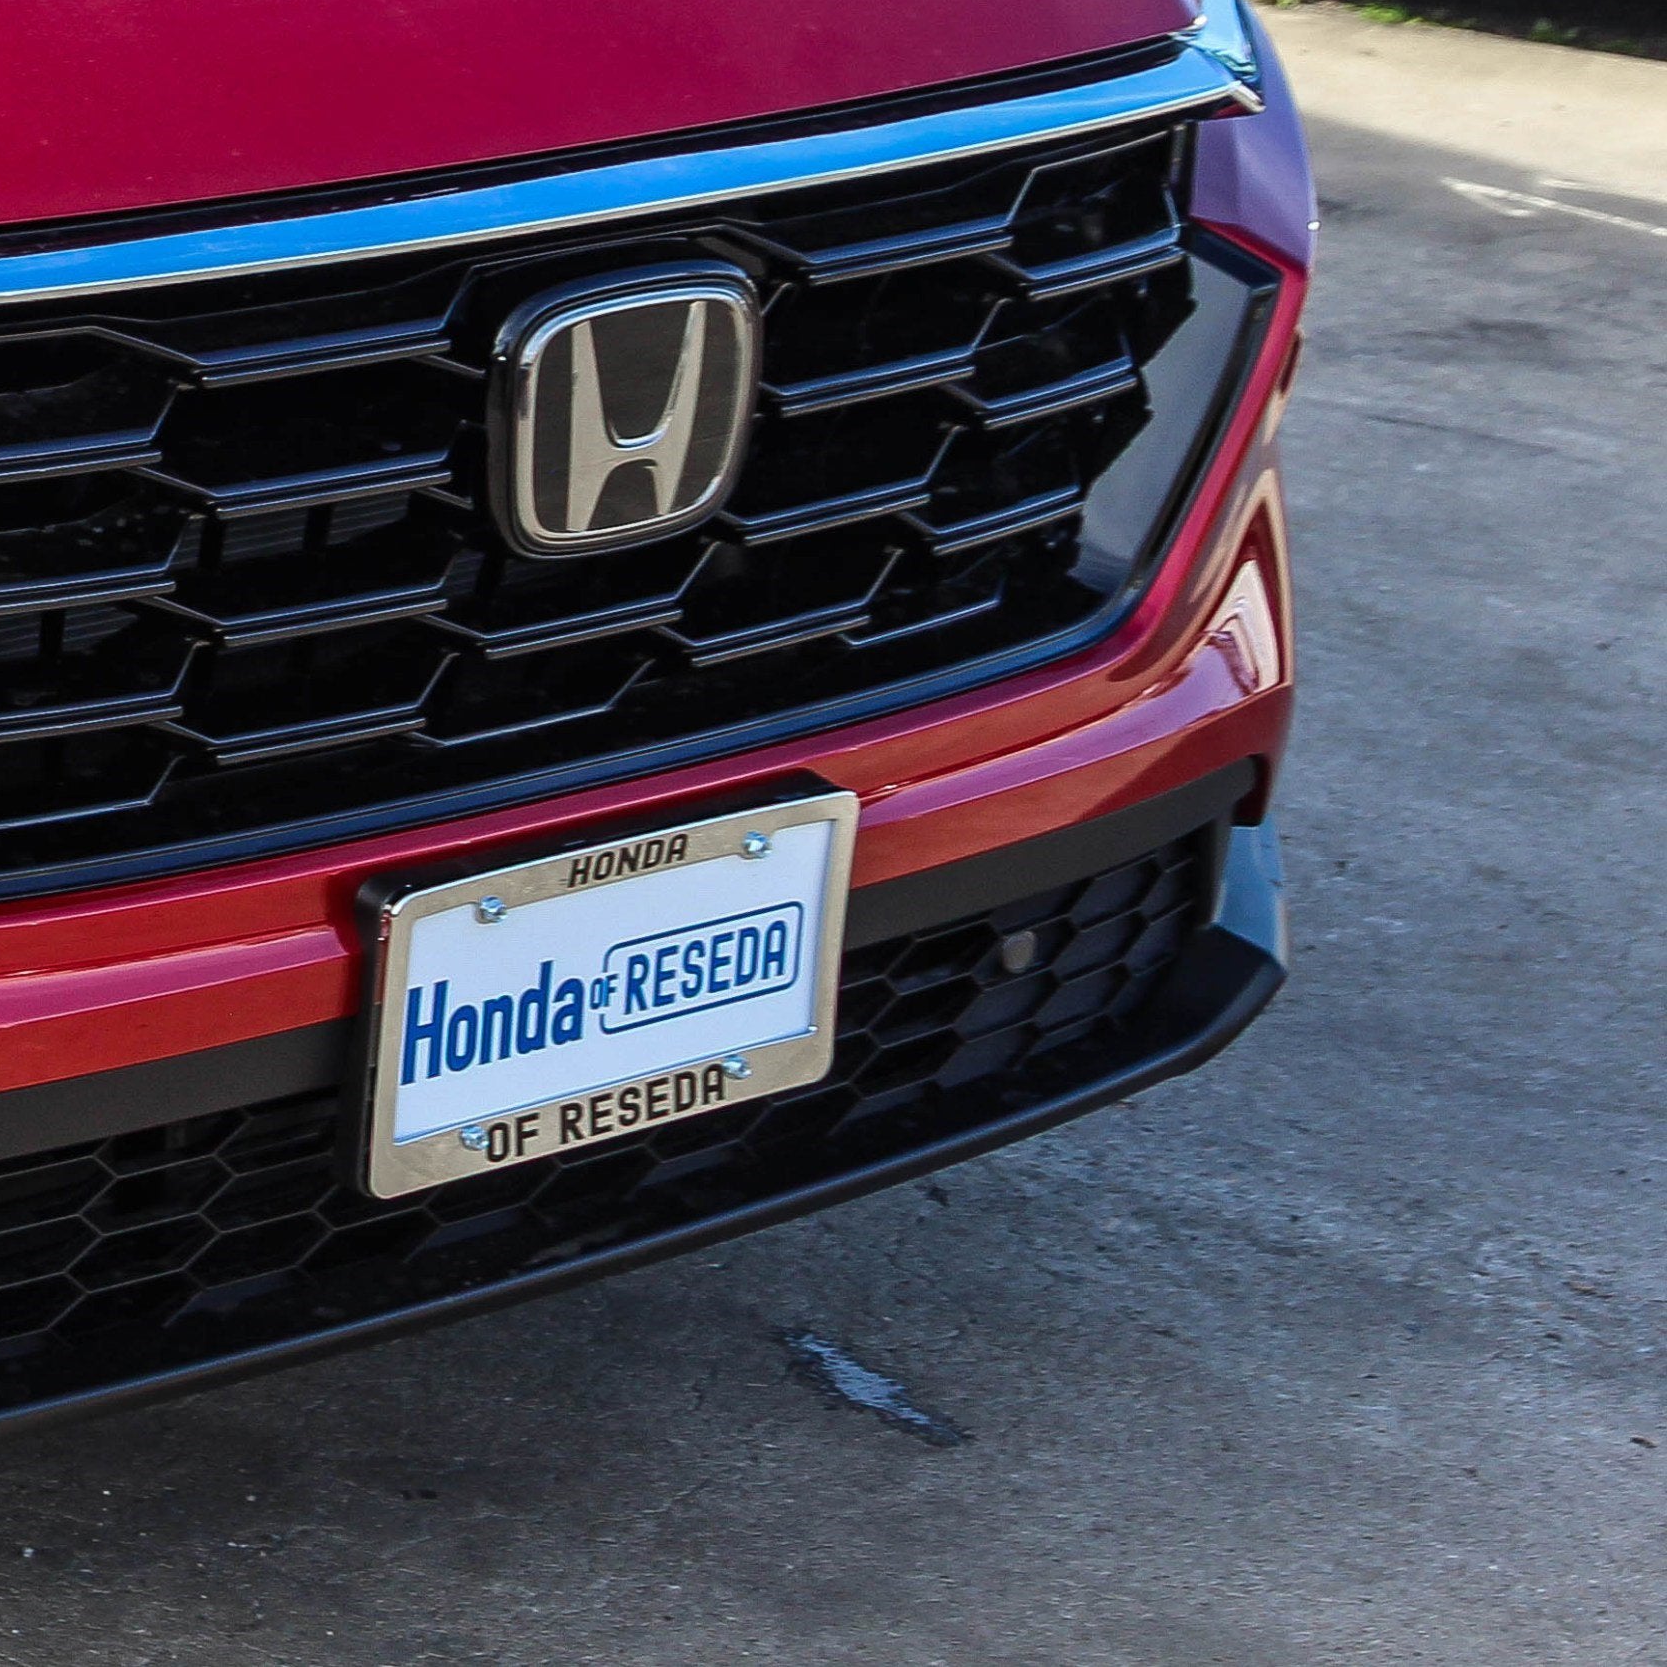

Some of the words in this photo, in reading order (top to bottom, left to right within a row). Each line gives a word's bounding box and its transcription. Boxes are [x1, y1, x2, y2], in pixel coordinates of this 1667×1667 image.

[568, 833, 688, 888] HONDA
[623, 920, 787, 1015] RESEDA
[400, 961, 585, 1085] Honda
[485, 1112, 540, 1164] OF
[559, 1062, 726, 1145] RESEDA
